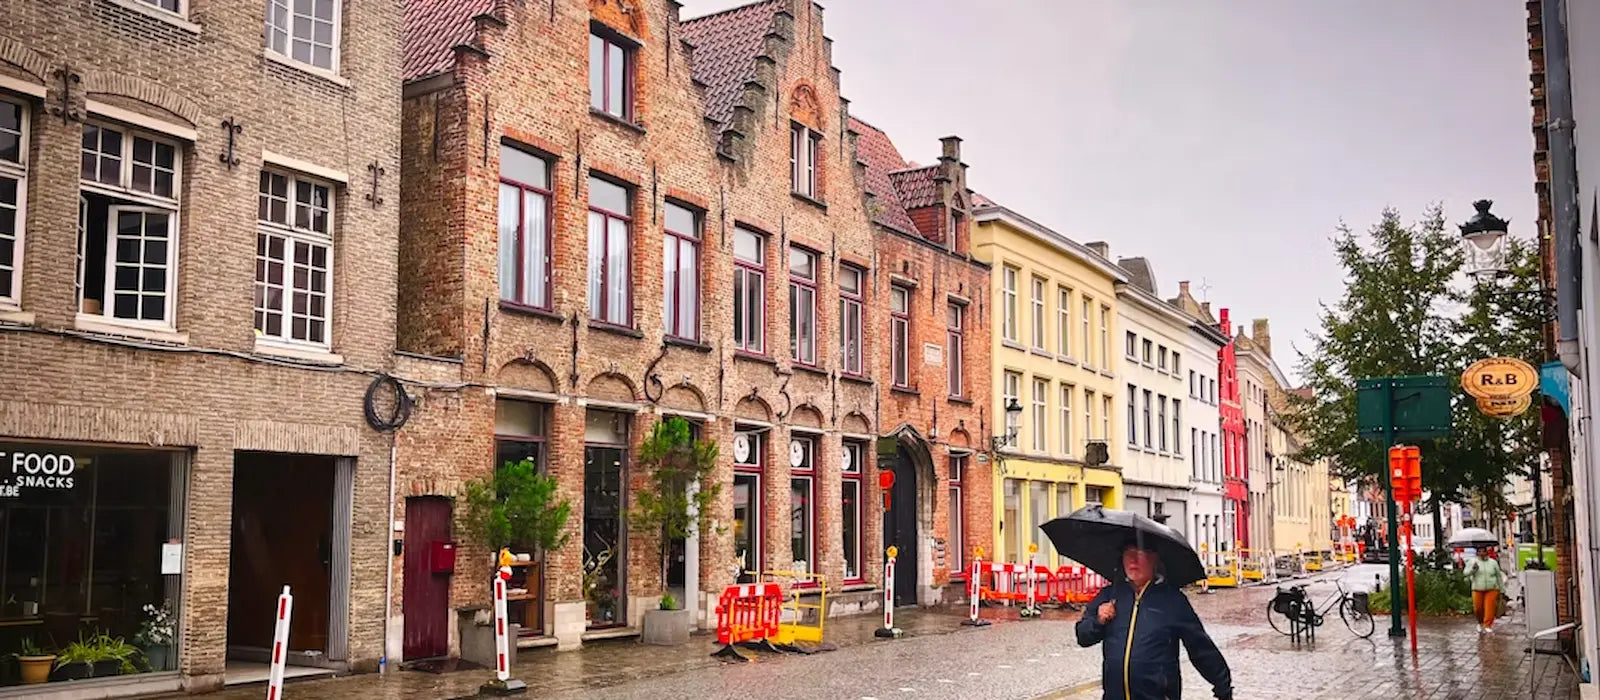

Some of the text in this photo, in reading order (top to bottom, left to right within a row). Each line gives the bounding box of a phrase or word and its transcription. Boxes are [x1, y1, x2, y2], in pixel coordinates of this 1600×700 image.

[1481, 373, 1518, 386] R&B
[12, 452, 75, 475] FOOD
[16, 475, 74, 489] SNACKS
